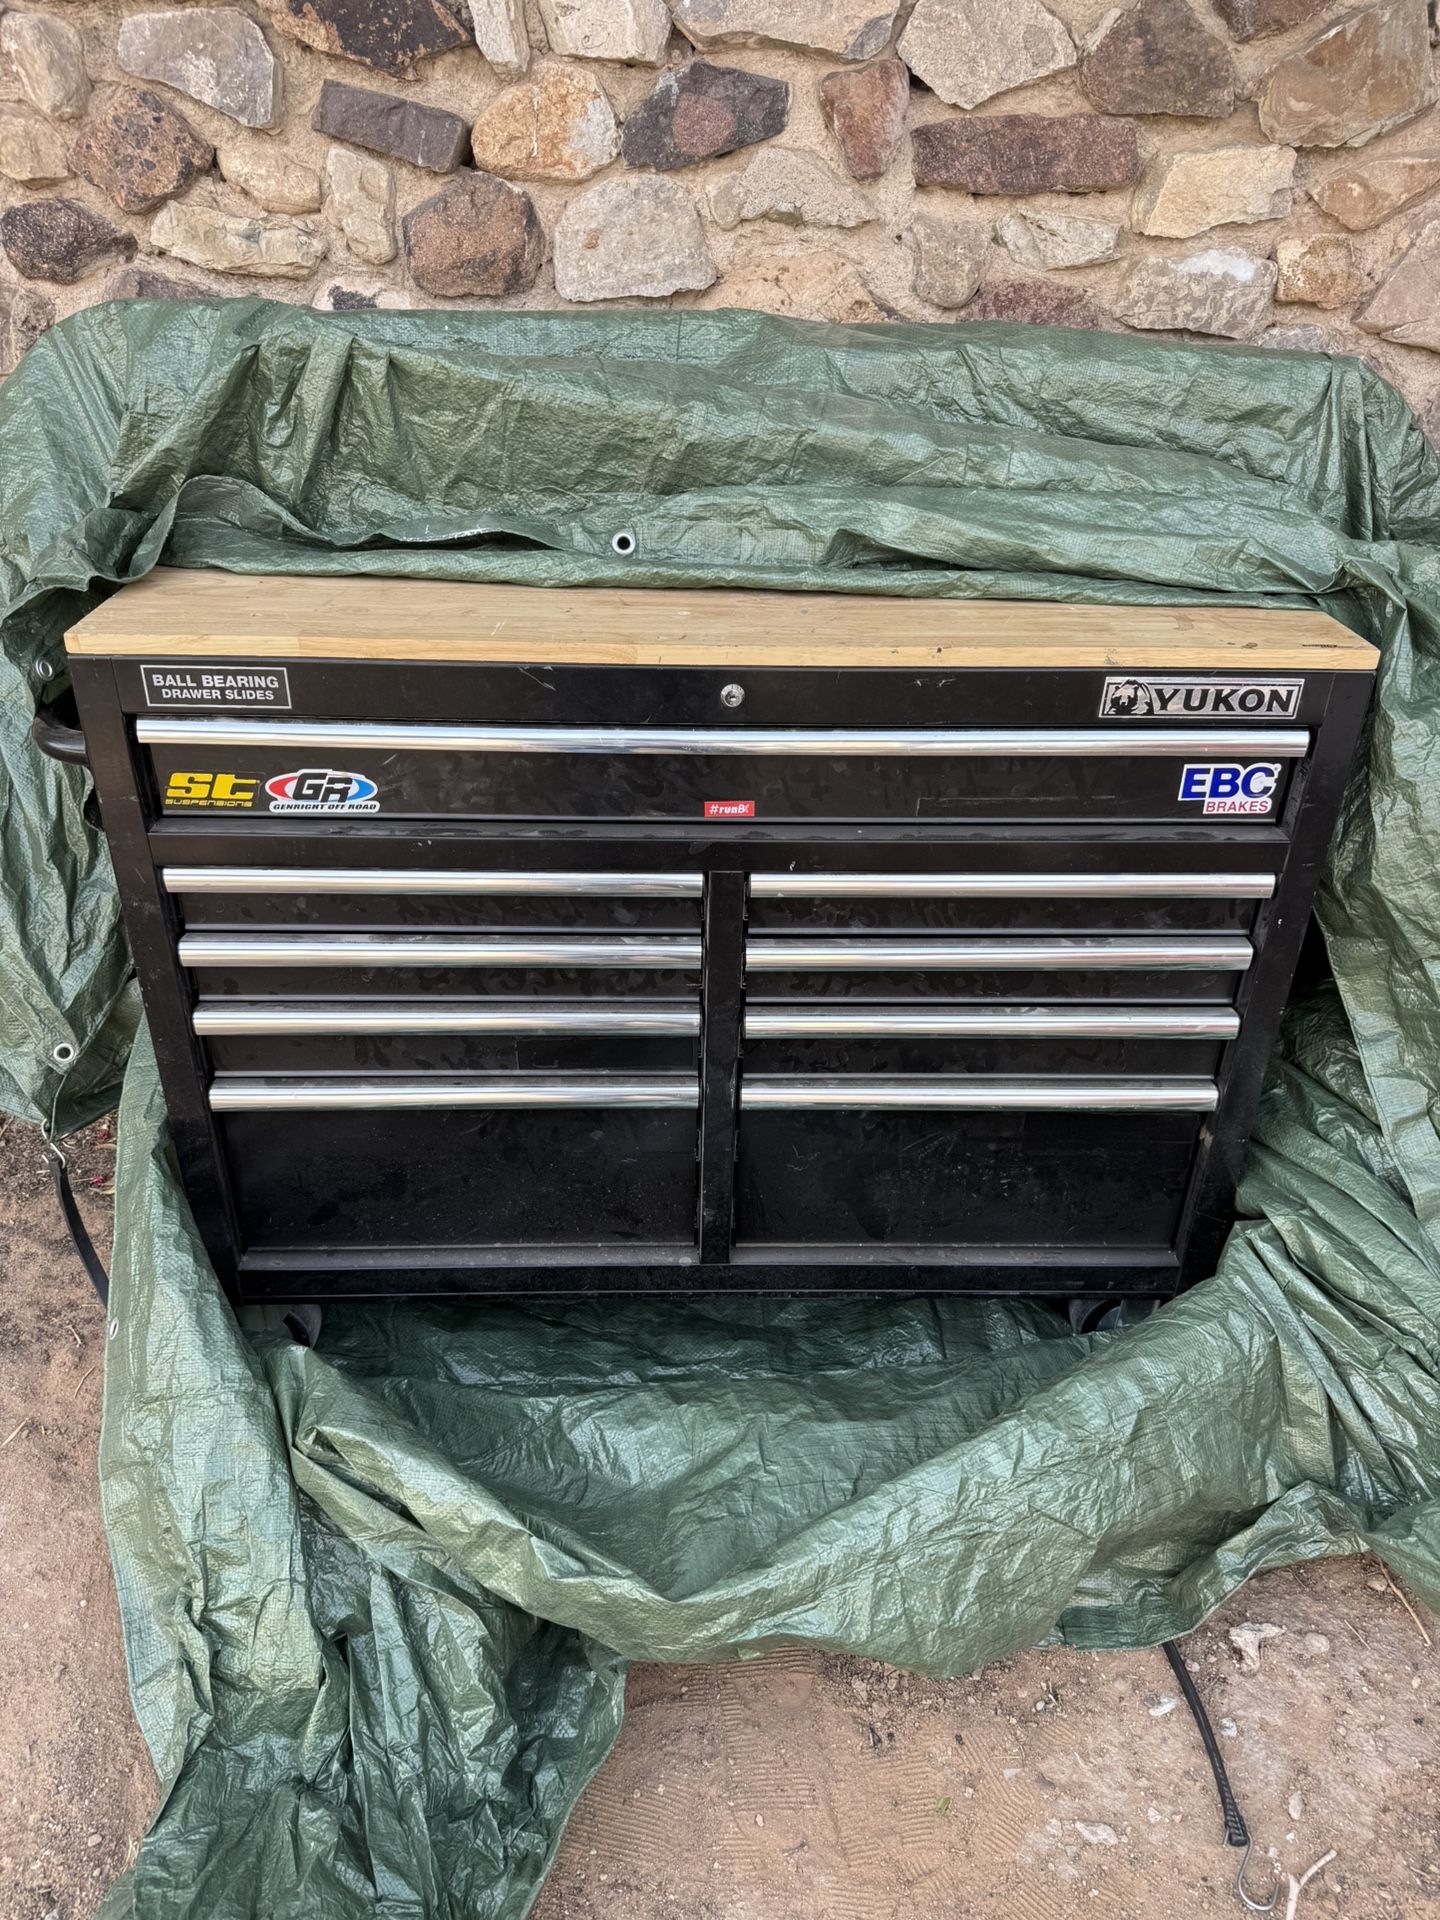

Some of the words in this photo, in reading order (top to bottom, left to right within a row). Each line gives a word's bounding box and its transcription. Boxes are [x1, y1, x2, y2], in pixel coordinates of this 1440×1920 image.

[152, 674, 197, 687] BALL
[201, 675, 279, 688] BEARING
[162, 688, 221, 699] DRAWER
[225, 689, 274, 700] SLIDES
[1154, 688, 1294, 713] YUKON
[292, 772, 353, 803] GR
[1181, 766, 1275, 799] EBC
[1205, 801, 1269, 813] BRAKES
